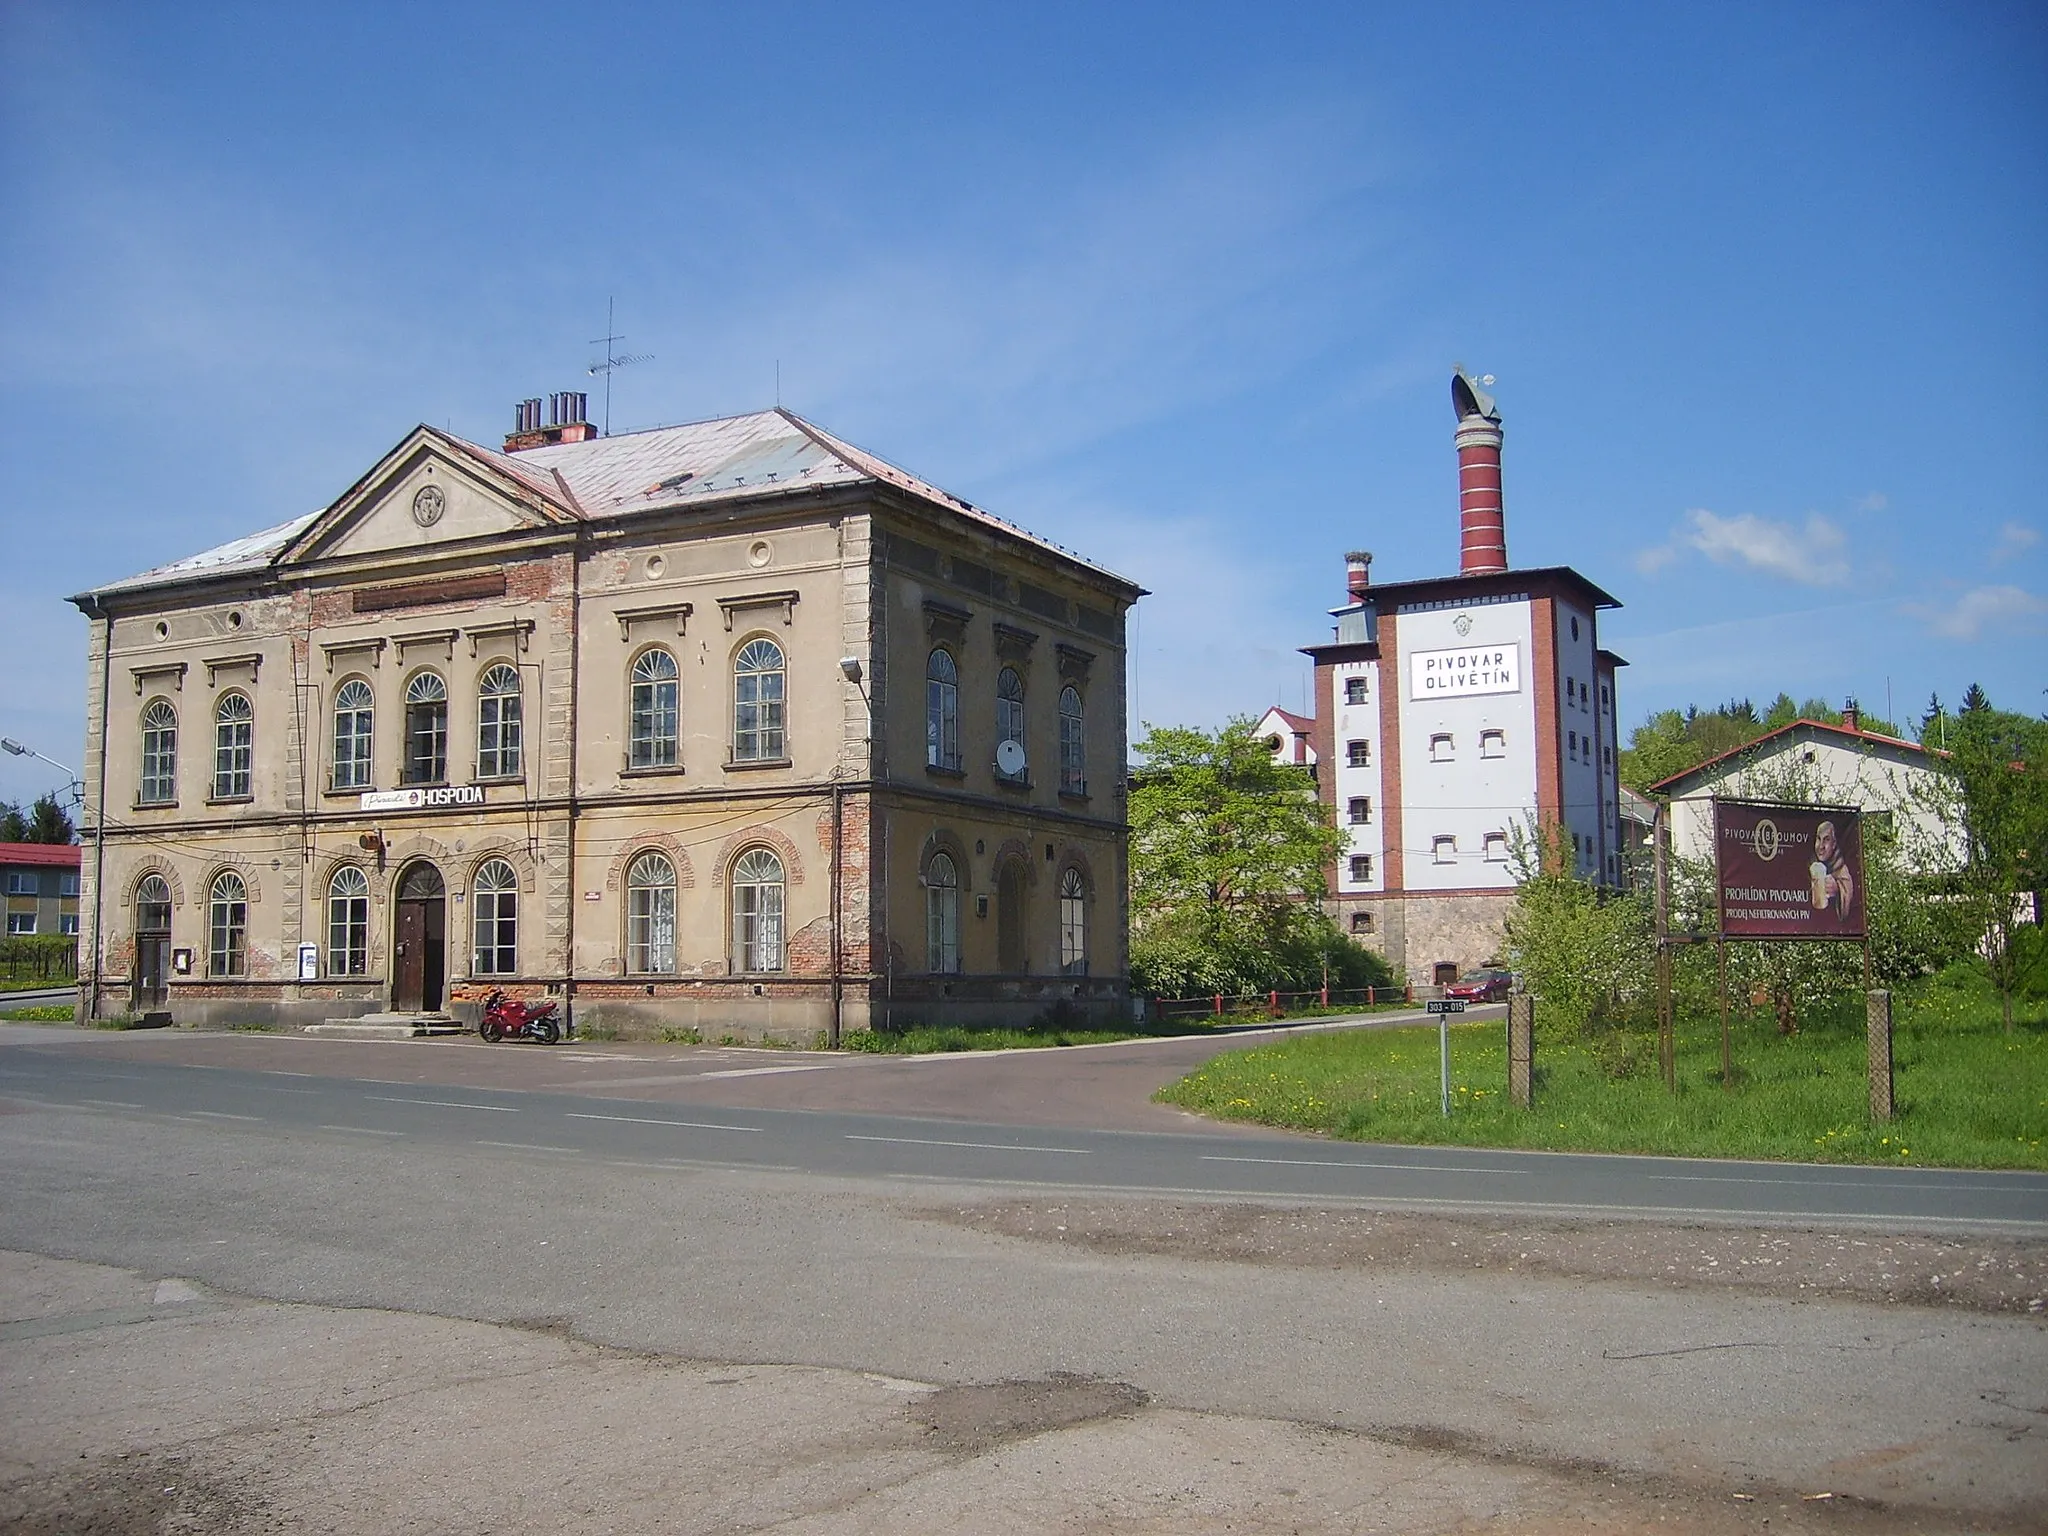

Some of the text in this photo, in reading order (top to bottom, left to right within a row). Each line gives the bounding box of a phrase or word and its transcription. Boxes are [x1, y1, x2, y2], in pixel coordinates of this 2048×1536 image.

[1427, 653, 1503, 670] PIVOVAR
[1426, 668, 1510, 689] OLIVĚTÍN
[421, 786, 483, 805] HOSPODA
[1724, 828, 1809, 843] PIVOVAR BROUMOV
[1725, 885, 1809, 903] PROHLÍDKY PIVOVARU
[1726, 907, 1810, 921] PRODEJ NEFILTROVANÝCH PIV
[1429, 1003, 1442, 1012] 303
[1450, 1002, 1463, 1012] 015
